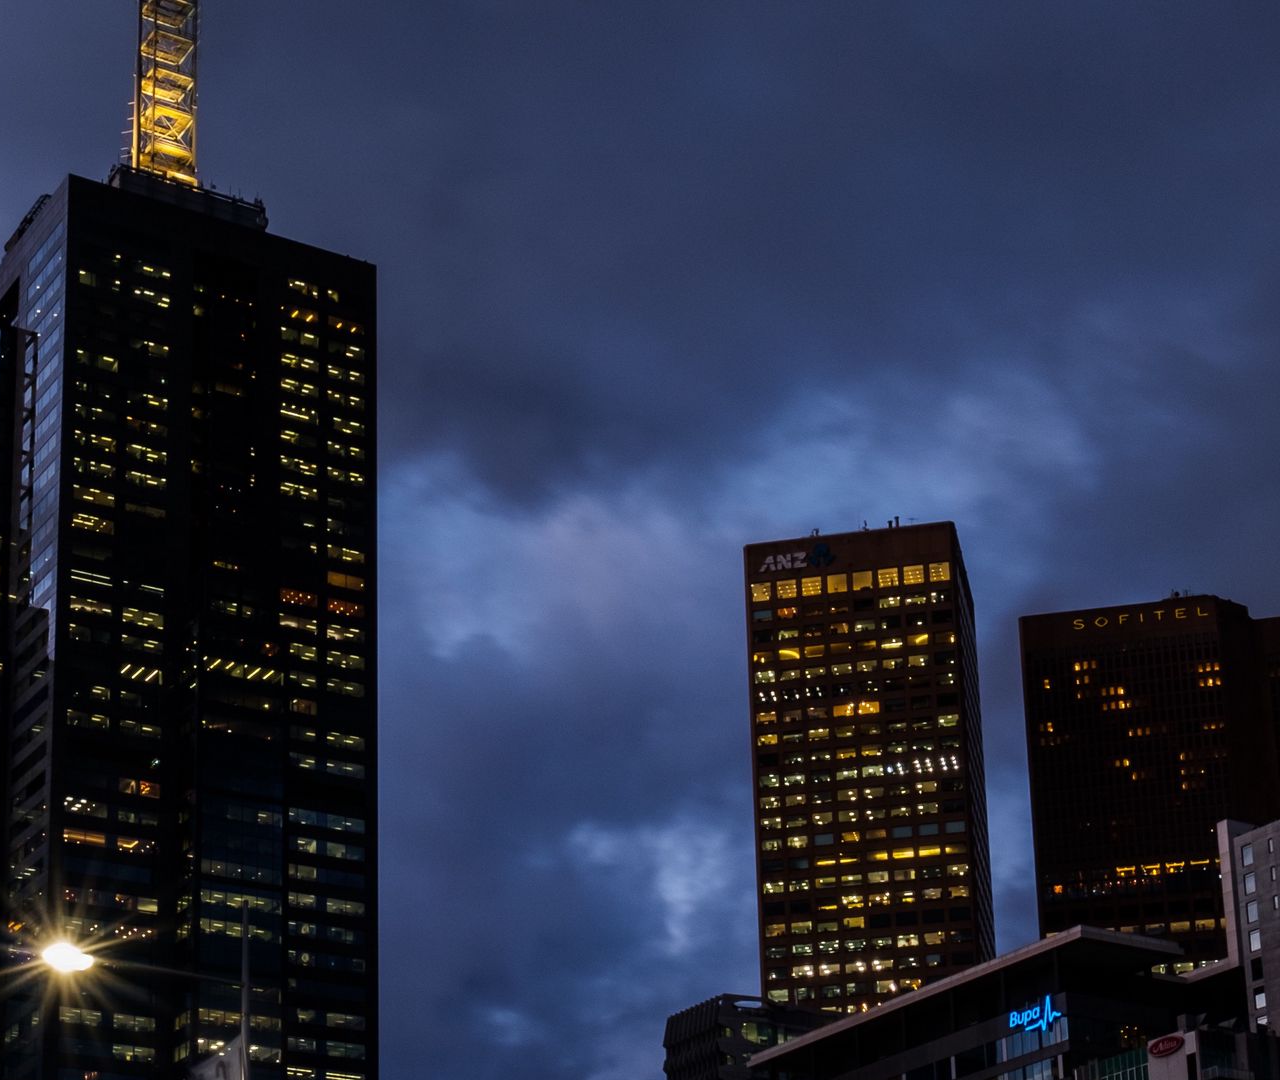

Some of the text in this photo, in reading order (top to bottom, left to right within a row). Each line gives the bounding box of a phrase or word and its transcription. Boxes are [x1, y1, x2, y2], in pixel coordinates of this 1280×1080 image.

[759, 552, 809, 573] ANZ
[1072, 606, 1209, 631] SOFITEL
[1009, 1005, 1040, 1028] Bupa
